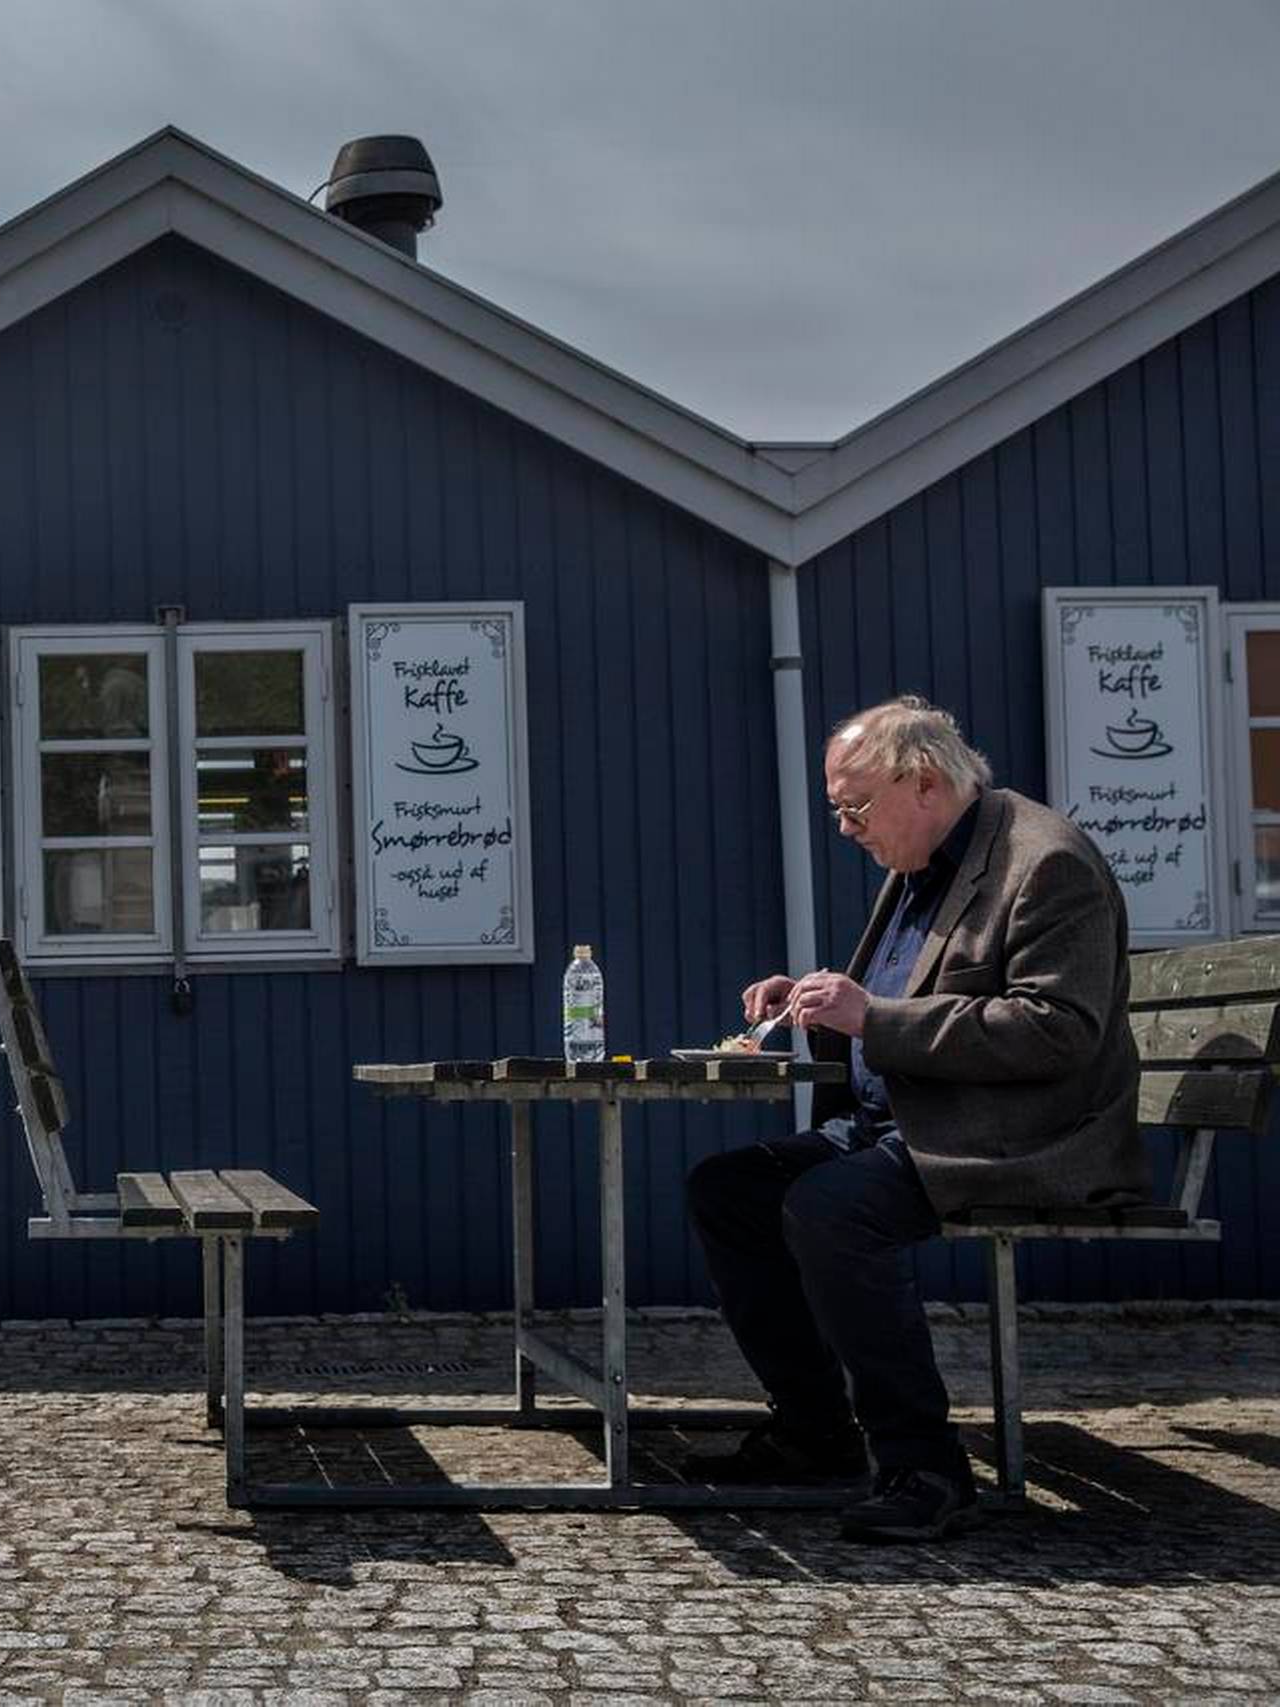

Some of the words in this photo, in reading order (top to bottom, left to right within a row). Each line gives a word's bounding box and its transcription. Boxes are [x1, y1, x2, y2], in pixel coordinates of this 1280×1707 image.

[1087, 641, 1163, 664] Frisklavet
[392, 656, 471, 679] Frisklavet
[1099, 664, 1163, 699] Kaffe
[405, 679, 468, 714] Kaffe
[1089, 782, 1176, 806] Frisksmurt
[393, 796, 481, 820] Frisksmurt
[371, 817, 511, 855] Smørrebrød
[1135, 844, 1158, 864] ud
[1165, 844, 1182, 866] af
[440, 860, 463, 880] ud
[470, 859, 489, 882] af
[418, 880, 459, 902] huset
